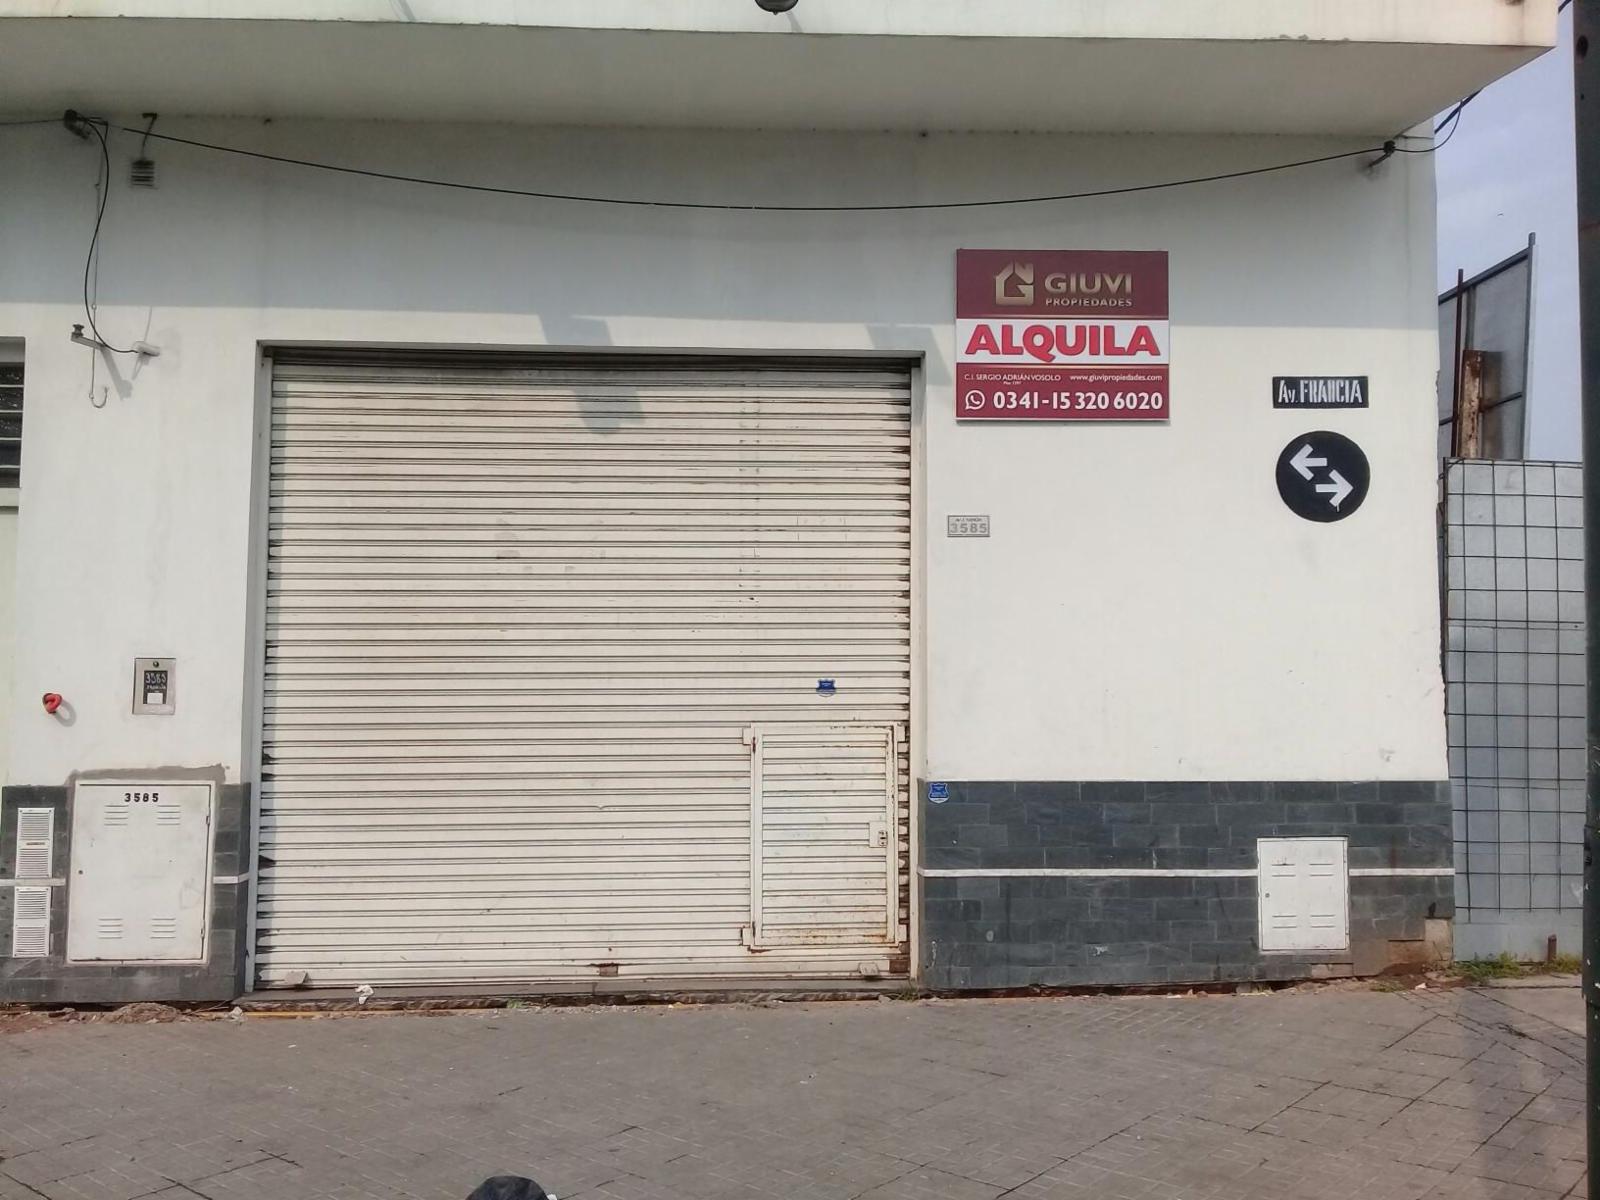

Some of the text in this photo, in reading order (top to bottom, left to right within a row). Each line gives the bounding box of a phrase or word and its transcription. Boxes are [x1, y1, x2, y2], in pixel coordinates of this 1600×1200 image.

[1044, 272, 1133, 295] GIUVI
[1045, 298, 1133, 308] PROPIEDADES
[964, 324, 1161, 363] ALQUILA
[976, 373, 1002, 381] SERGIO
[1031, 374, 1062, 382] VOSOLO
[1070, 373, 1163, 383] www.giuvipropiedades.com
[1278, 380, 1363, 403] Av. FRANCIA
[1074, 392, 1110, 410] 320
[1113, 392, 1163, 411] 6020
[950, 523, 987, 533] 3585
[124, 792, 159, 802] 3585
